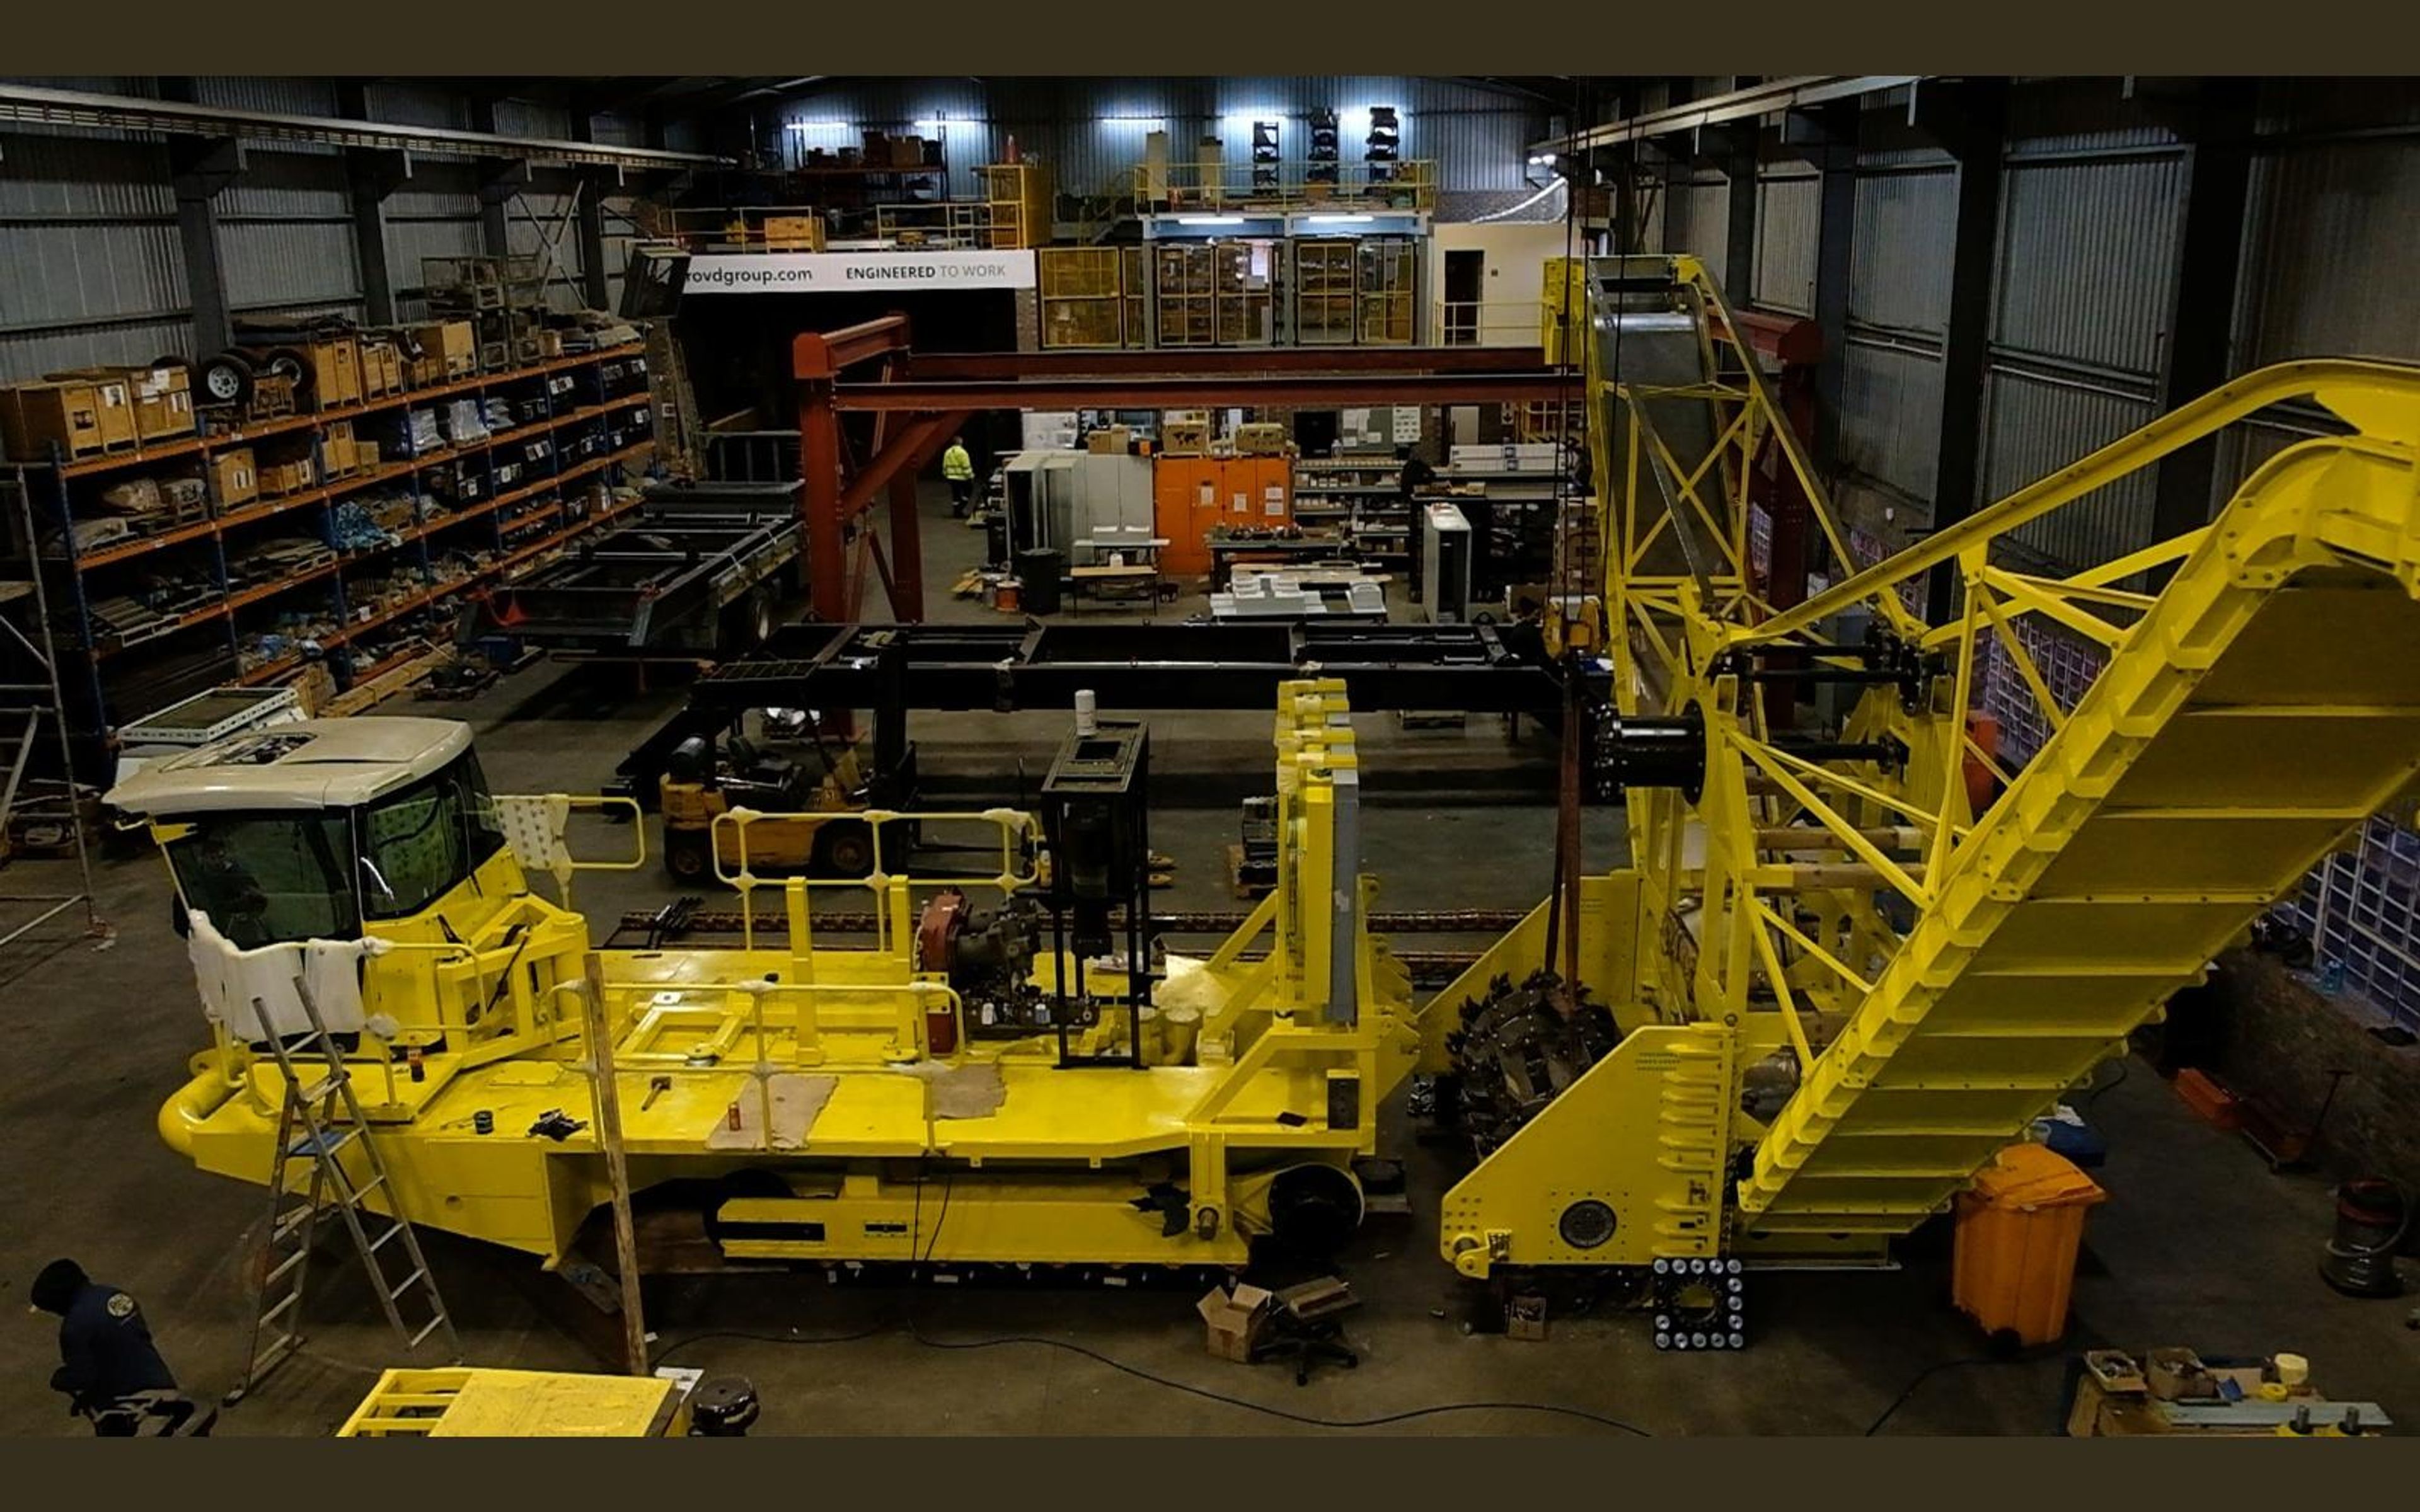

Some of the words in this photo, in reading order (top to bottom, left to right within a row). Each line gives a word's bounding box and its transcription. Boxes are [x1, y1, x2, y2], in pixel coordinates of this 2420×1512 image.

[847, 266, 936, 279] ENGINEERED
[940, 265, 959, 278] TO
[963, 264, 1006, 277] WORK
